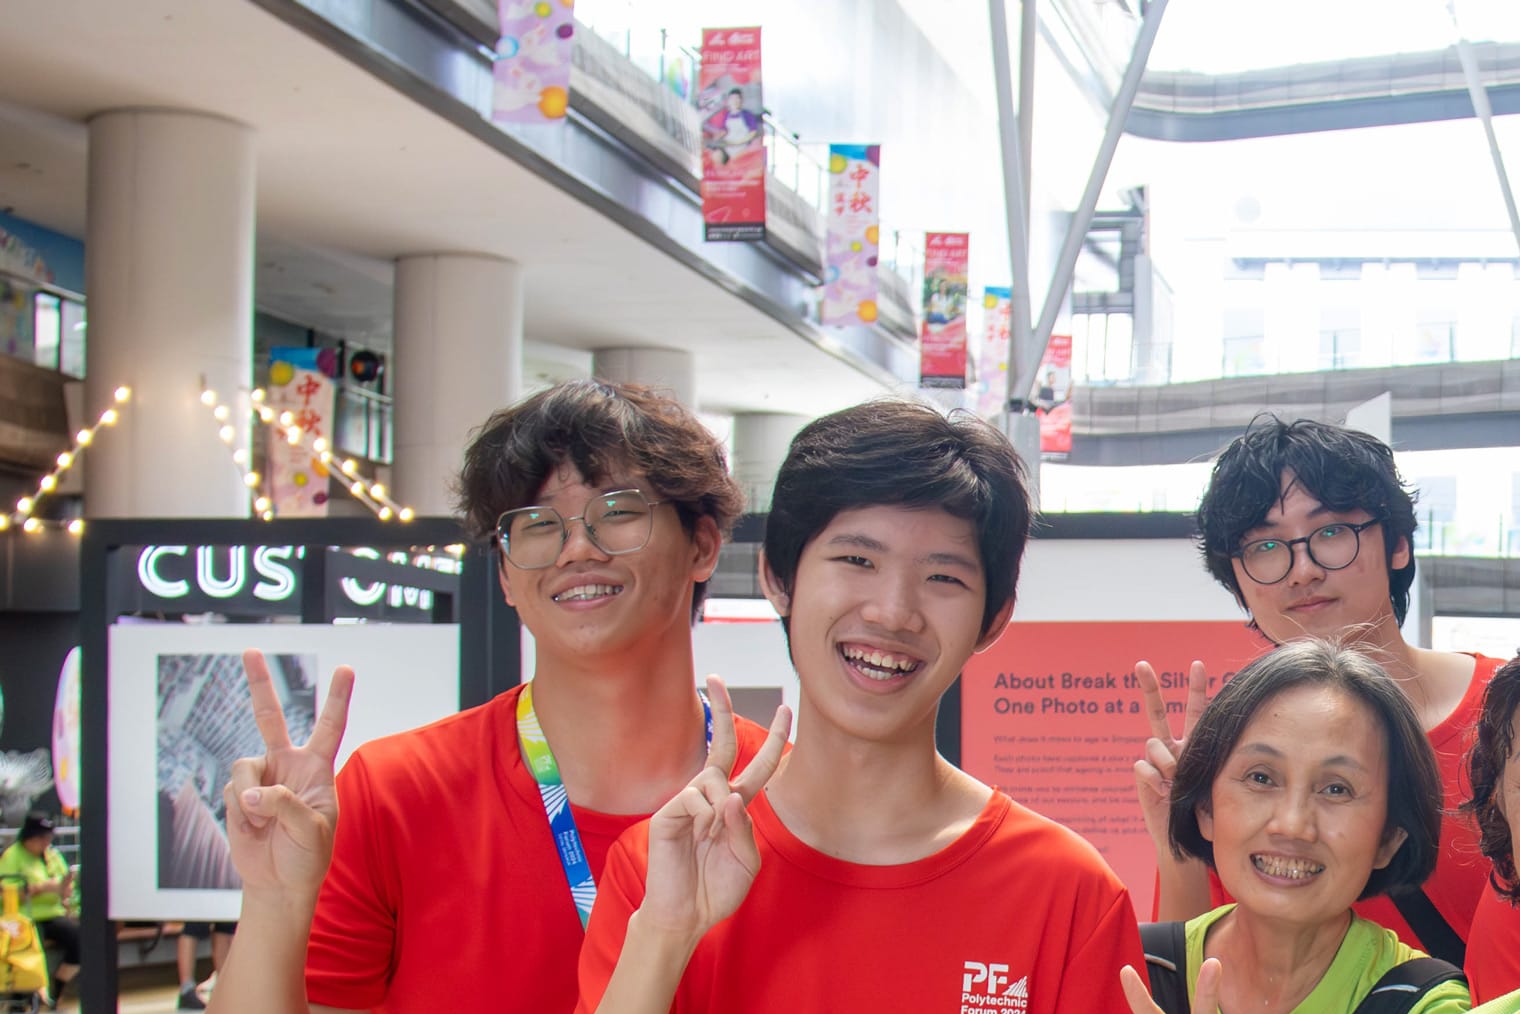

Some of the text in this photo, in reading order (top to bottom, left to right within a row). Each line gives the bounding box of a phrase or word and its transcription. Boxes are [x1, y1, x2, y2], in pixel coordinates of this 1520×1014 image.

[993, 672, 1055, 689] About
[1061, 673, 1116, 689] Break
[1123, 672, 1142, 689] th
[1160, 672, 1216, 689] Silr
[993, 698, 1140, 714] One Photo at a
[963, 961, 1009, 994] PF
[961, 992, 1028, 1009] Polytechnic
